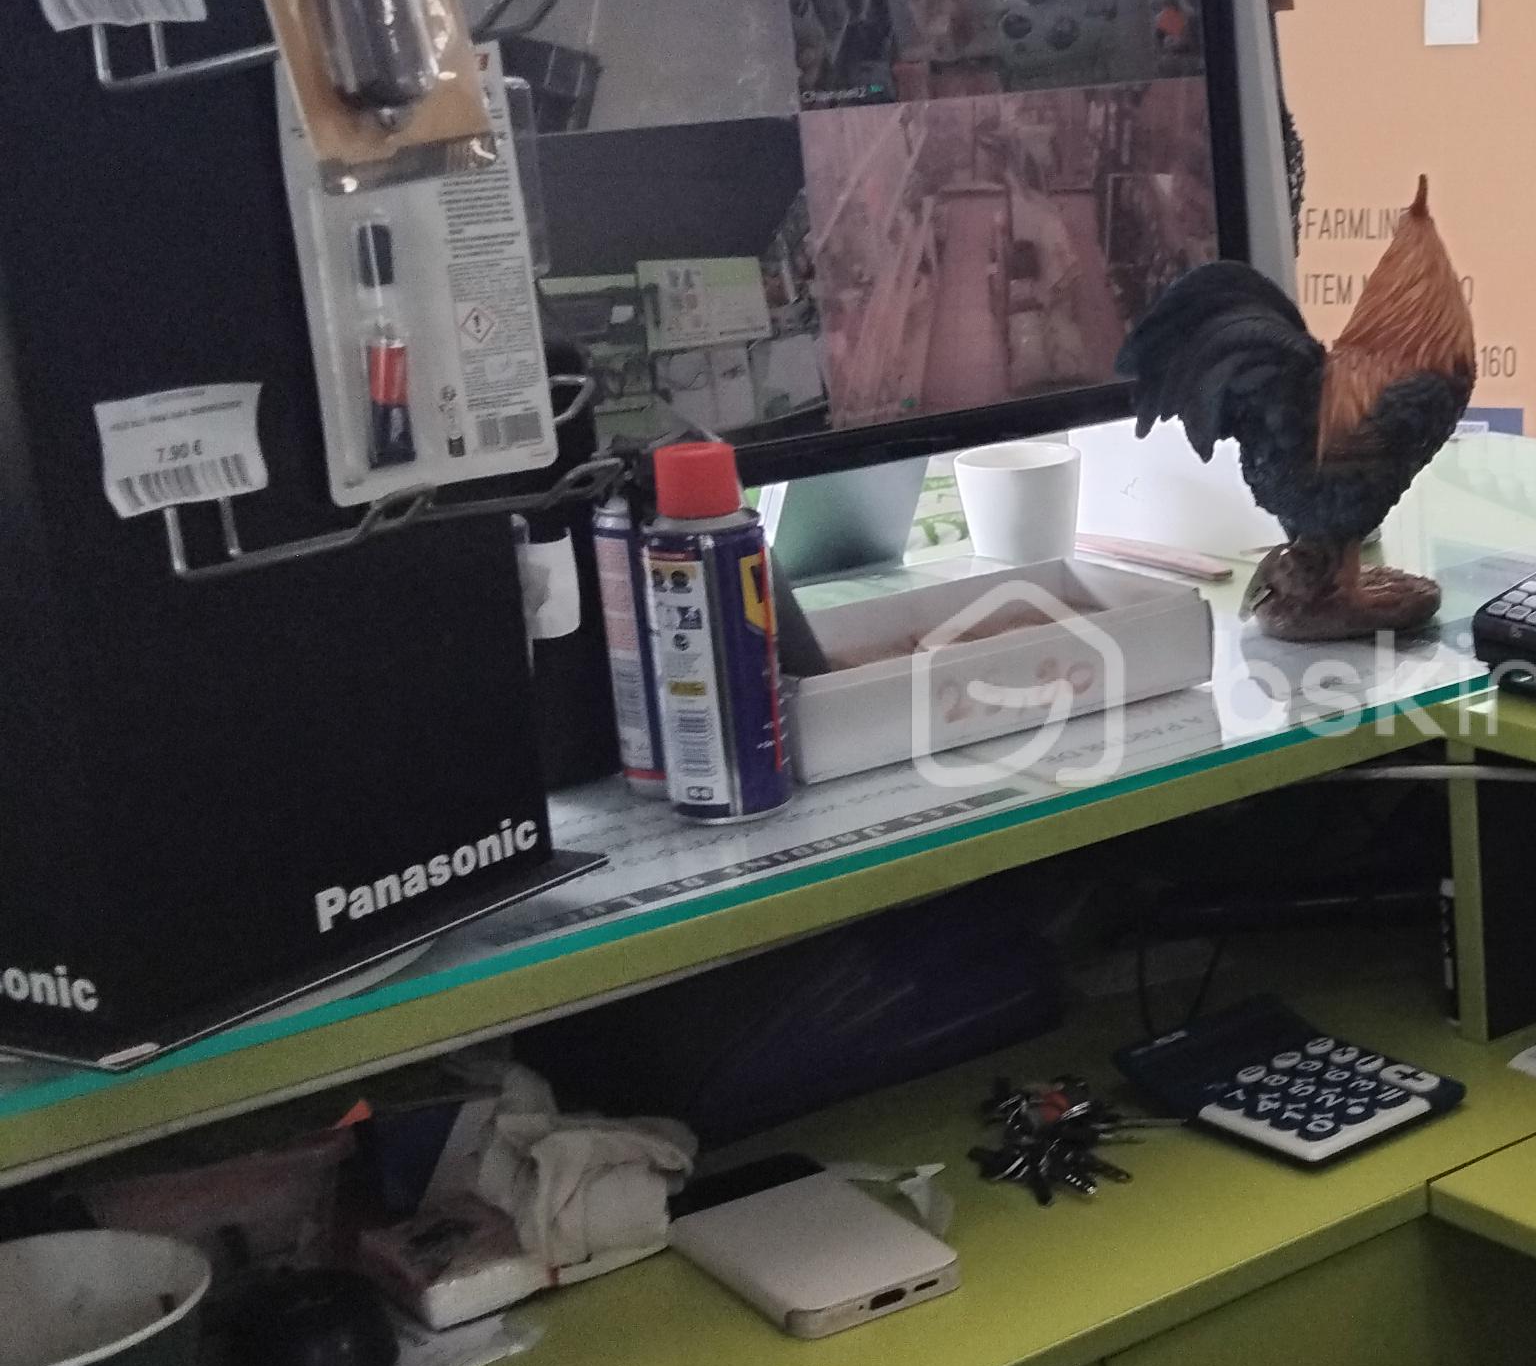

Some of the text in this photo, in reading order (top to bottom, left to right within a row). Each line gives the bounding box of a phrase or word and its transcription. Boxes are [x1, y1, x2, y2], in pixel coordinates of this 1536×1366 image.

[1304, 208, 1411, 240] FARMLIN
[1304, 274, 1353, 305] ITEM
[1480, 345, 1516, 378] 160
[314, 818, 538, 933] Panasonic
[0, 965, 98, 1013] onic
